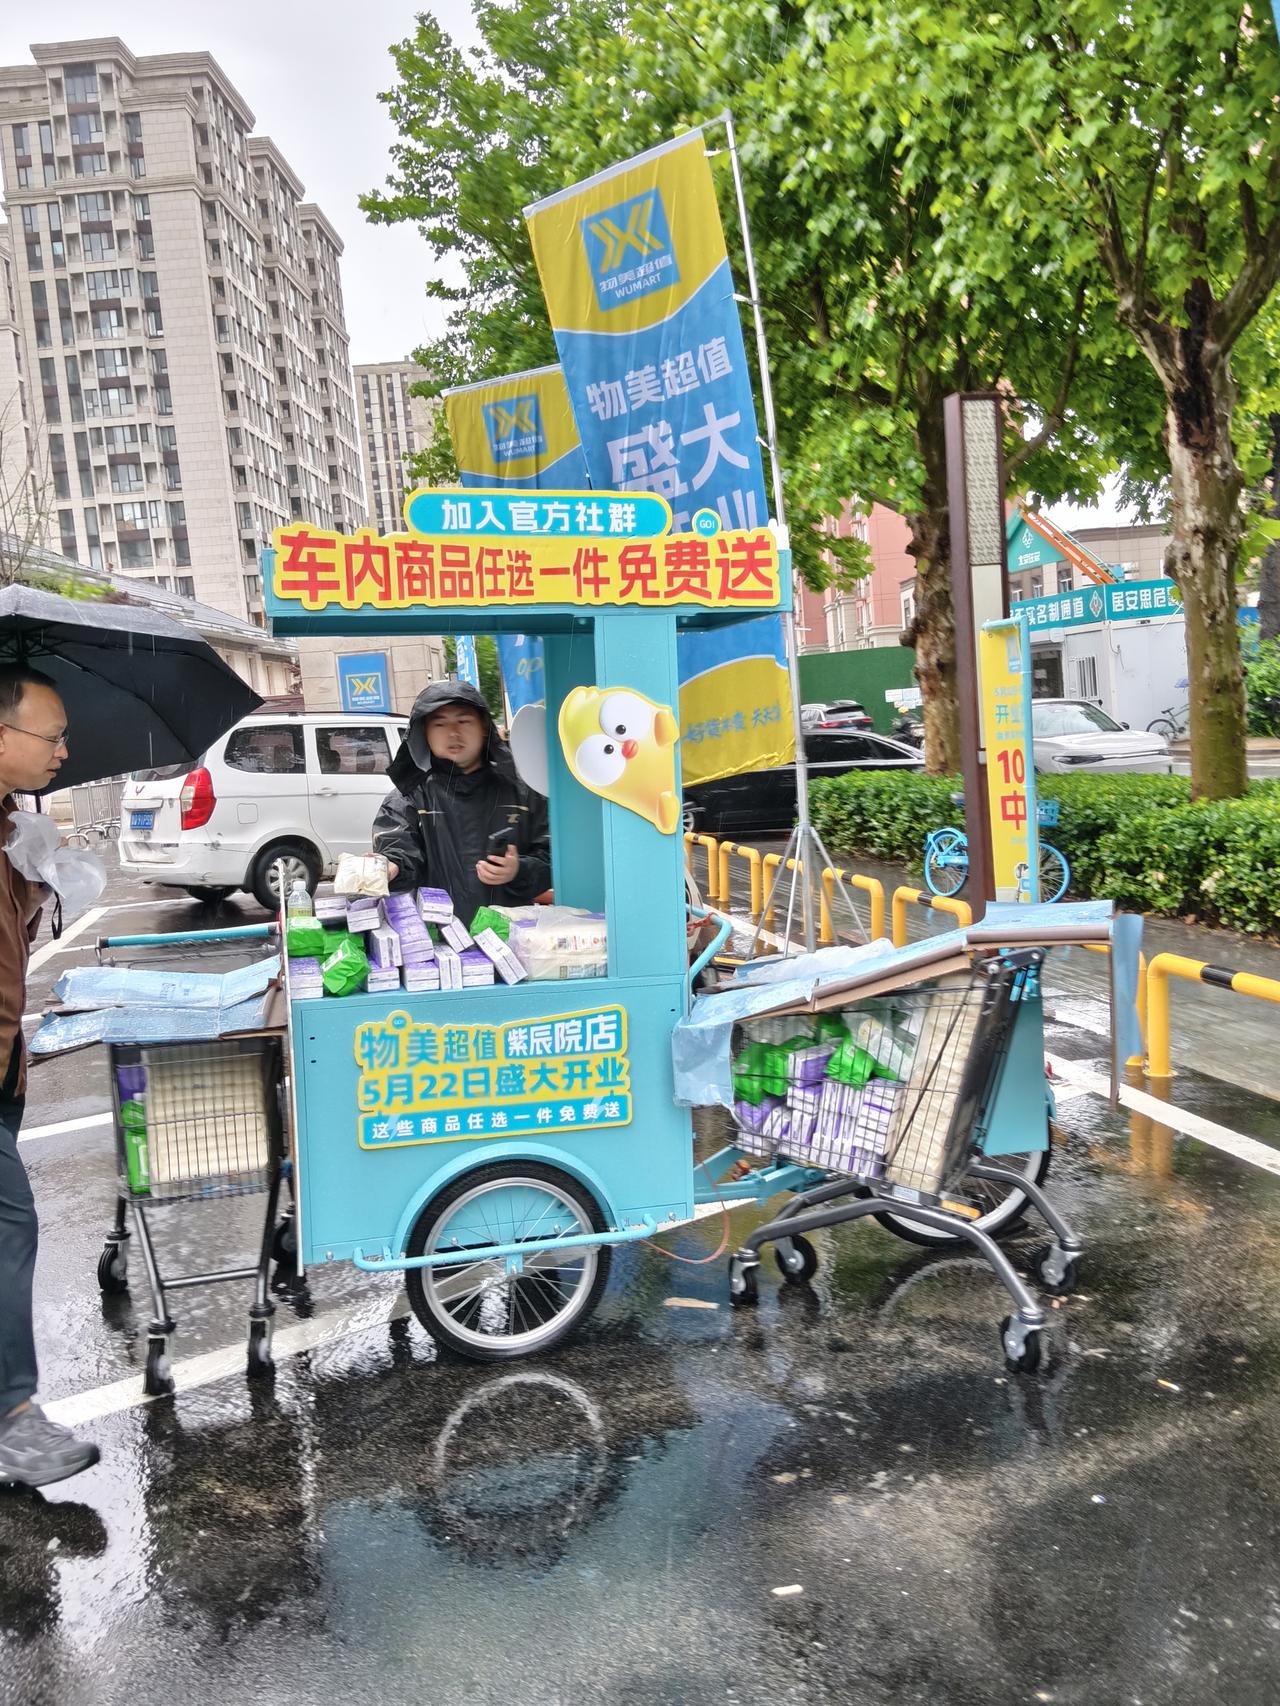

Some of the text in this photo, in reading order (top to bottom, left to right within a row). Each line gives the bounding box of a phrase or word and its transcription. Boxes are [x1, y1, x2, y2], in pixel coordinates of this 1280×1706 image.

[614, 273, 662, 298] WUMART
[586, 336, 733, 421] 物美超值
[606, 402, 750, 500] 盛大
[442, 500, 636, 532] 加入官方社群
[699, 519, 716, 529] GO!
[280, 532, 774, 601] 车内商品任选一件免费送
[997, 748, 1025, 784] 10
[1000, 790, 1027, 831] 中
[360, 1014, 618, 1071] 物美超值 紫辰院店
[363, 1057, 625, 1107] 5月22日盛大开业
[372, 1101, 621, 1140] 这些商品任选一件免费送
